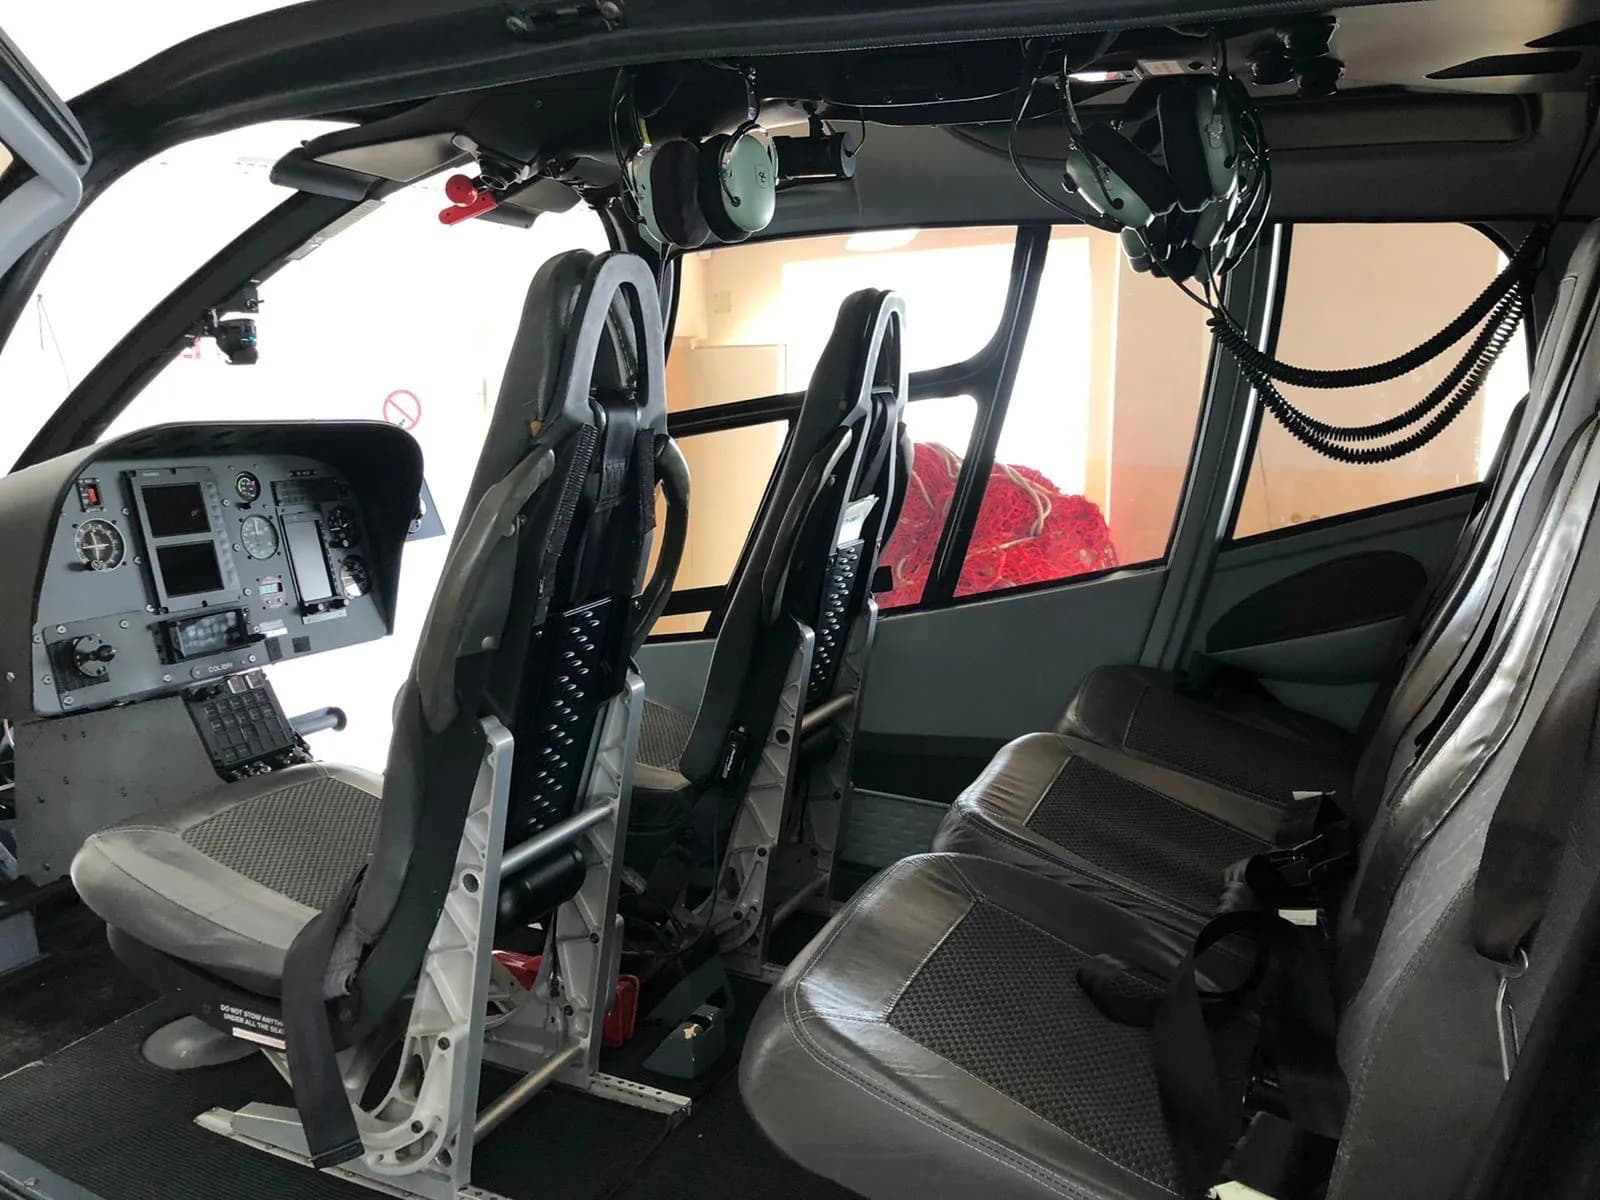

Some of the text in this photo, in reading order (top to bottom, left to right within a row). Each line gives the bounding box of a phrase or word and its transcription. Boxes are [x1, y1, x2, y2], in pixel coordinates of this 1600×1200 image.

[220, 1004, 285, 1027] DO NOT STOW ANYTH
[223, 1013, 244, 1024] UNDER
[244, 1018, 257, 1028] ALL
[256, 1022, 270, 1031] THE
